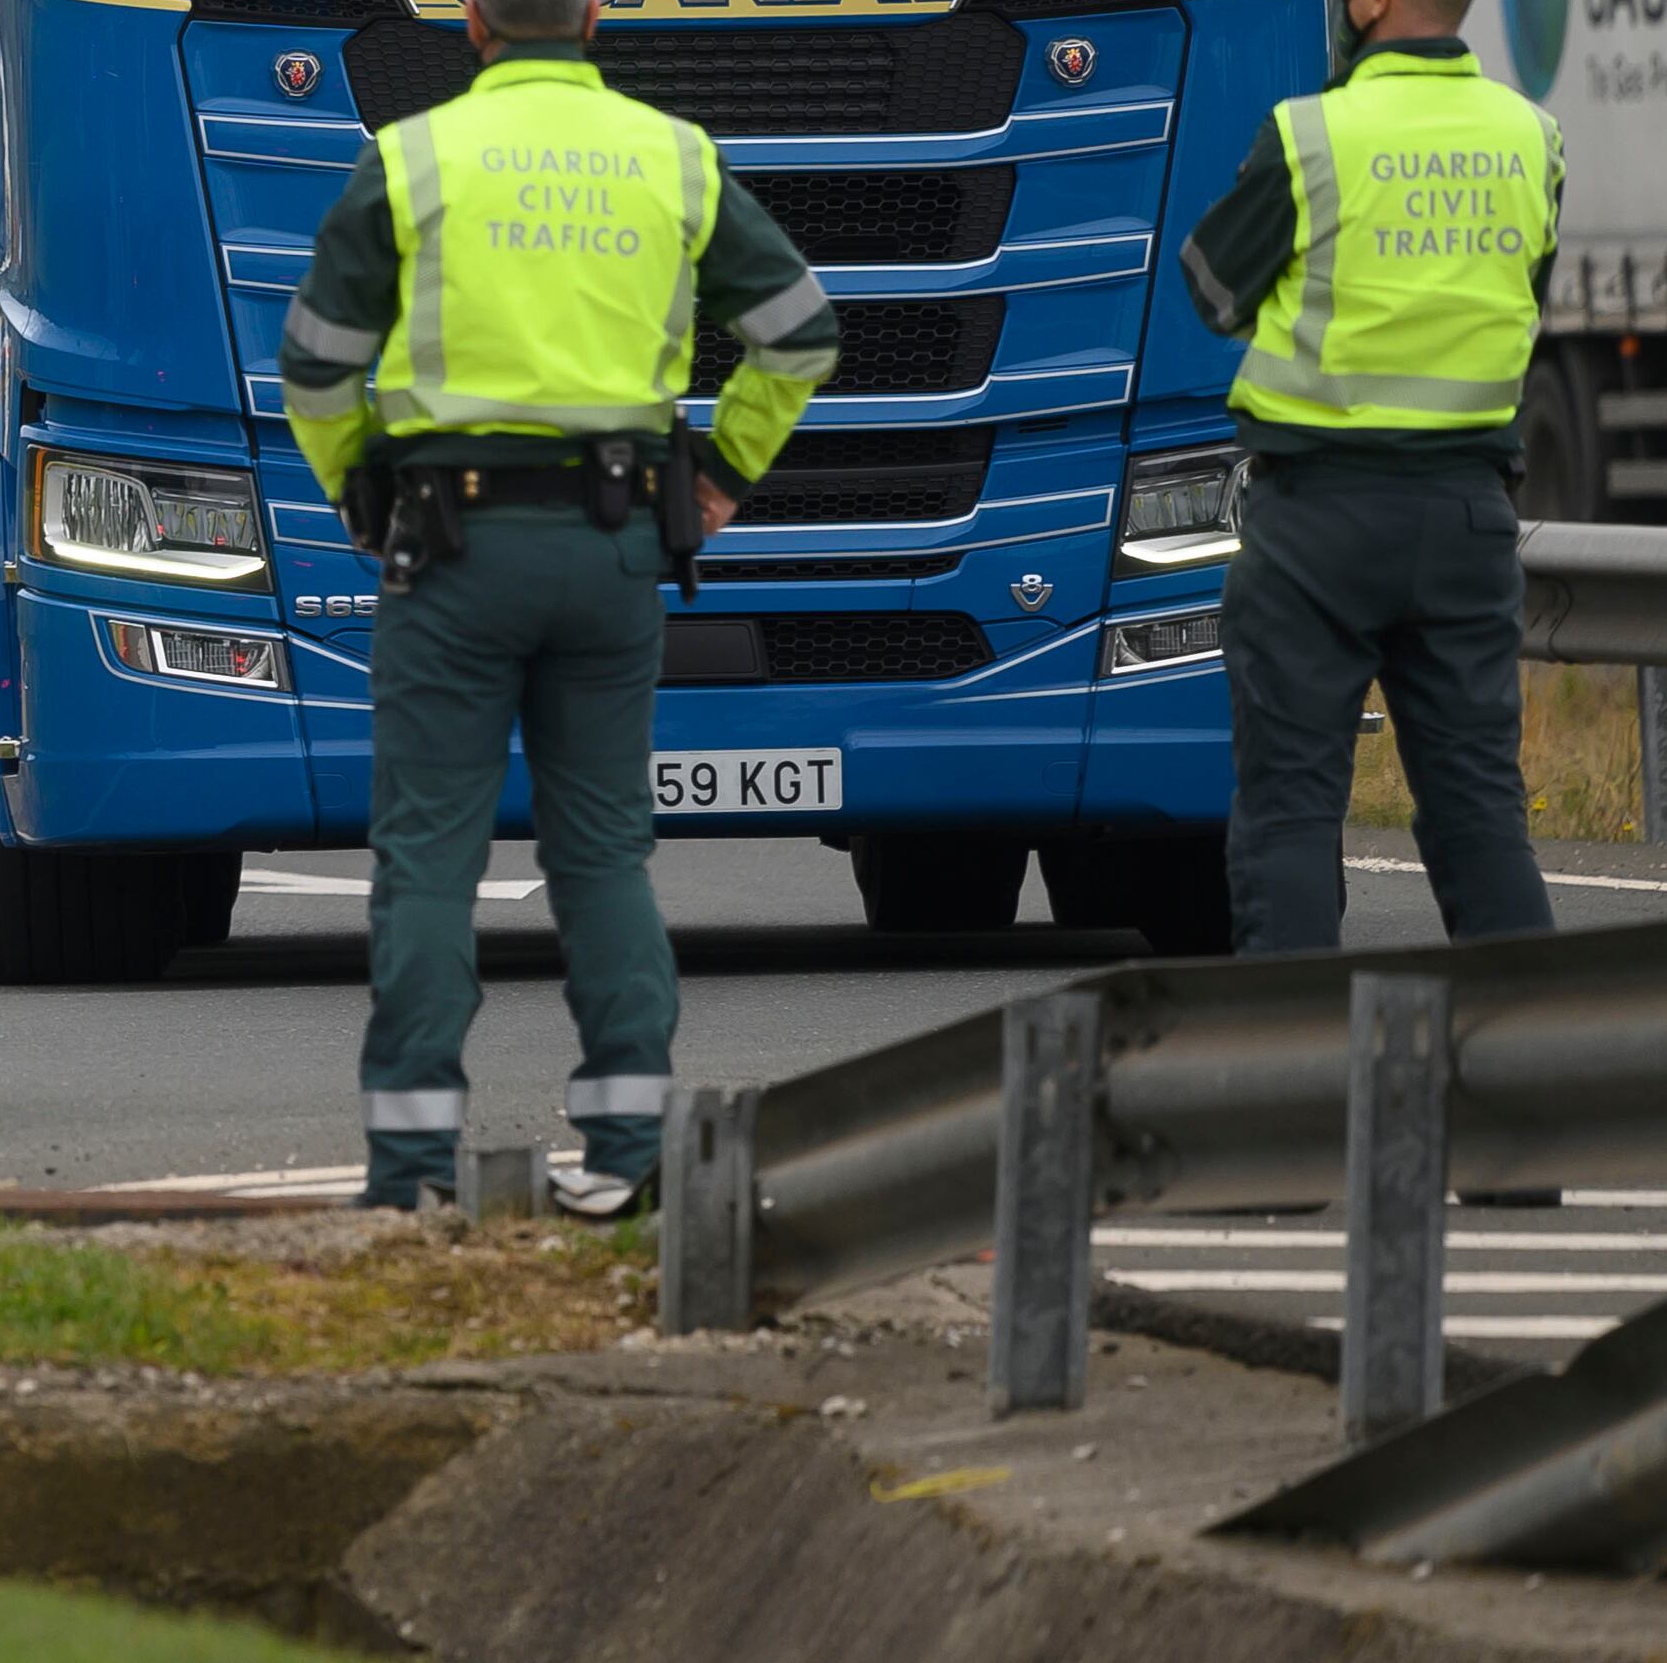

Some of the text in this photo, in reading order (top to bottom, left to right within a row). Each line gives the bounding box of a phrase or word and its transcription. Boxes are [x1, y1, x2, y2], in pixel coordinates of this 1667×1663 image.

[481, 147, 645, 180] GUARDIA
[1370, 151, 1526, 182] GUARDIA
[518, 184, 615, 216] CIVIL
[1405, 189, 1496, 219] CIVIL
[487, 221, 640, 257] TRAFICO
[1375, 226, 1523, 256] TRAFICO
[657, 760, 834, 806] 59 KGT
